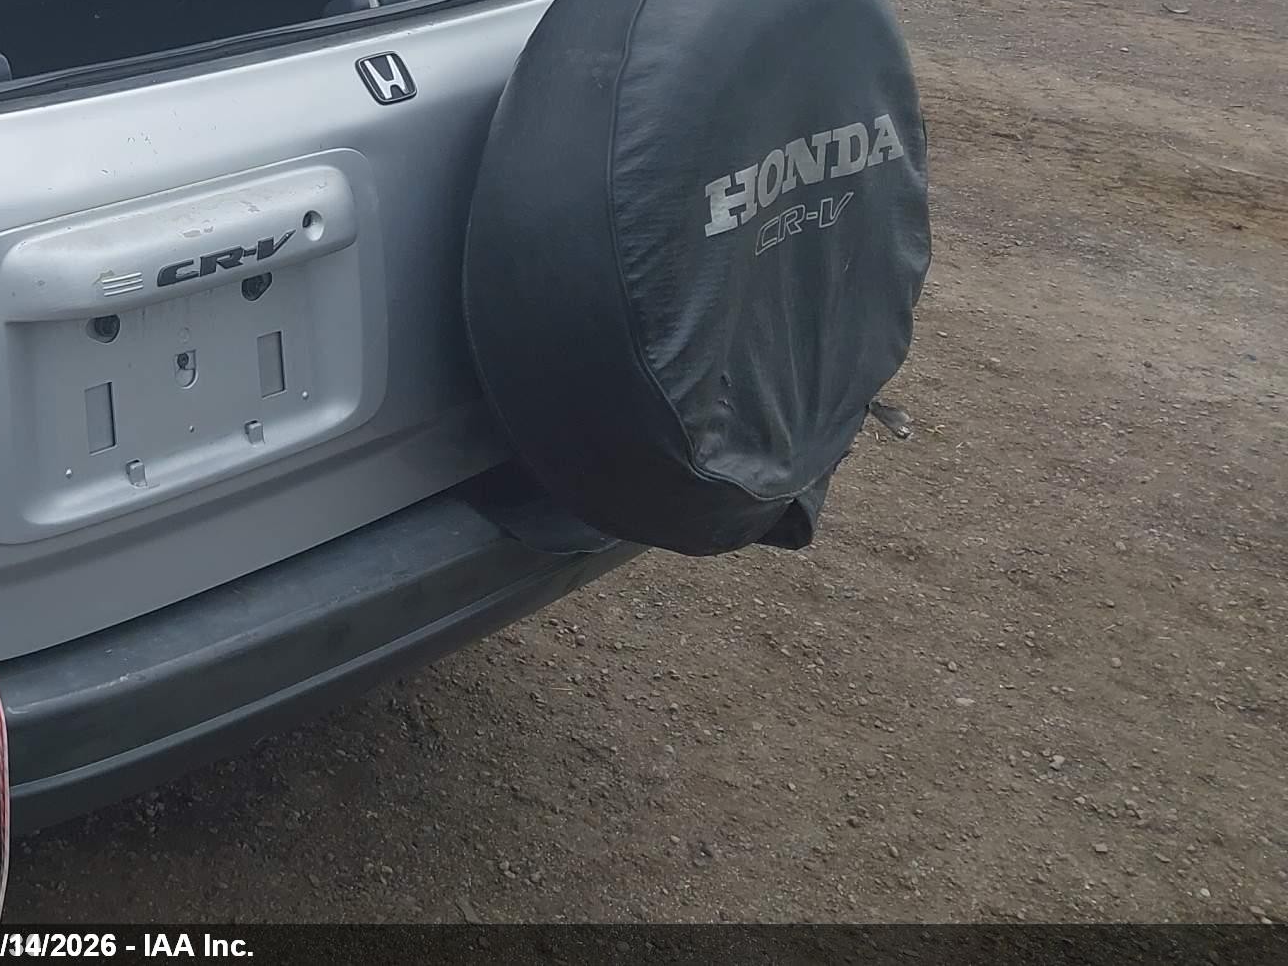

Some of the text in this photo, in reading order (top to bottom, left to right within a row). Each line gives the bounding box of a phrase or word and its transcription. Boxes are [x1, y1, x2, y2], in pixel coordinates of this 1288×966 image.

[704, 113, 905, 237] HONDA
[755, 191, 854, 256] CR-V
[156, 229, 297, 287] CR-V
